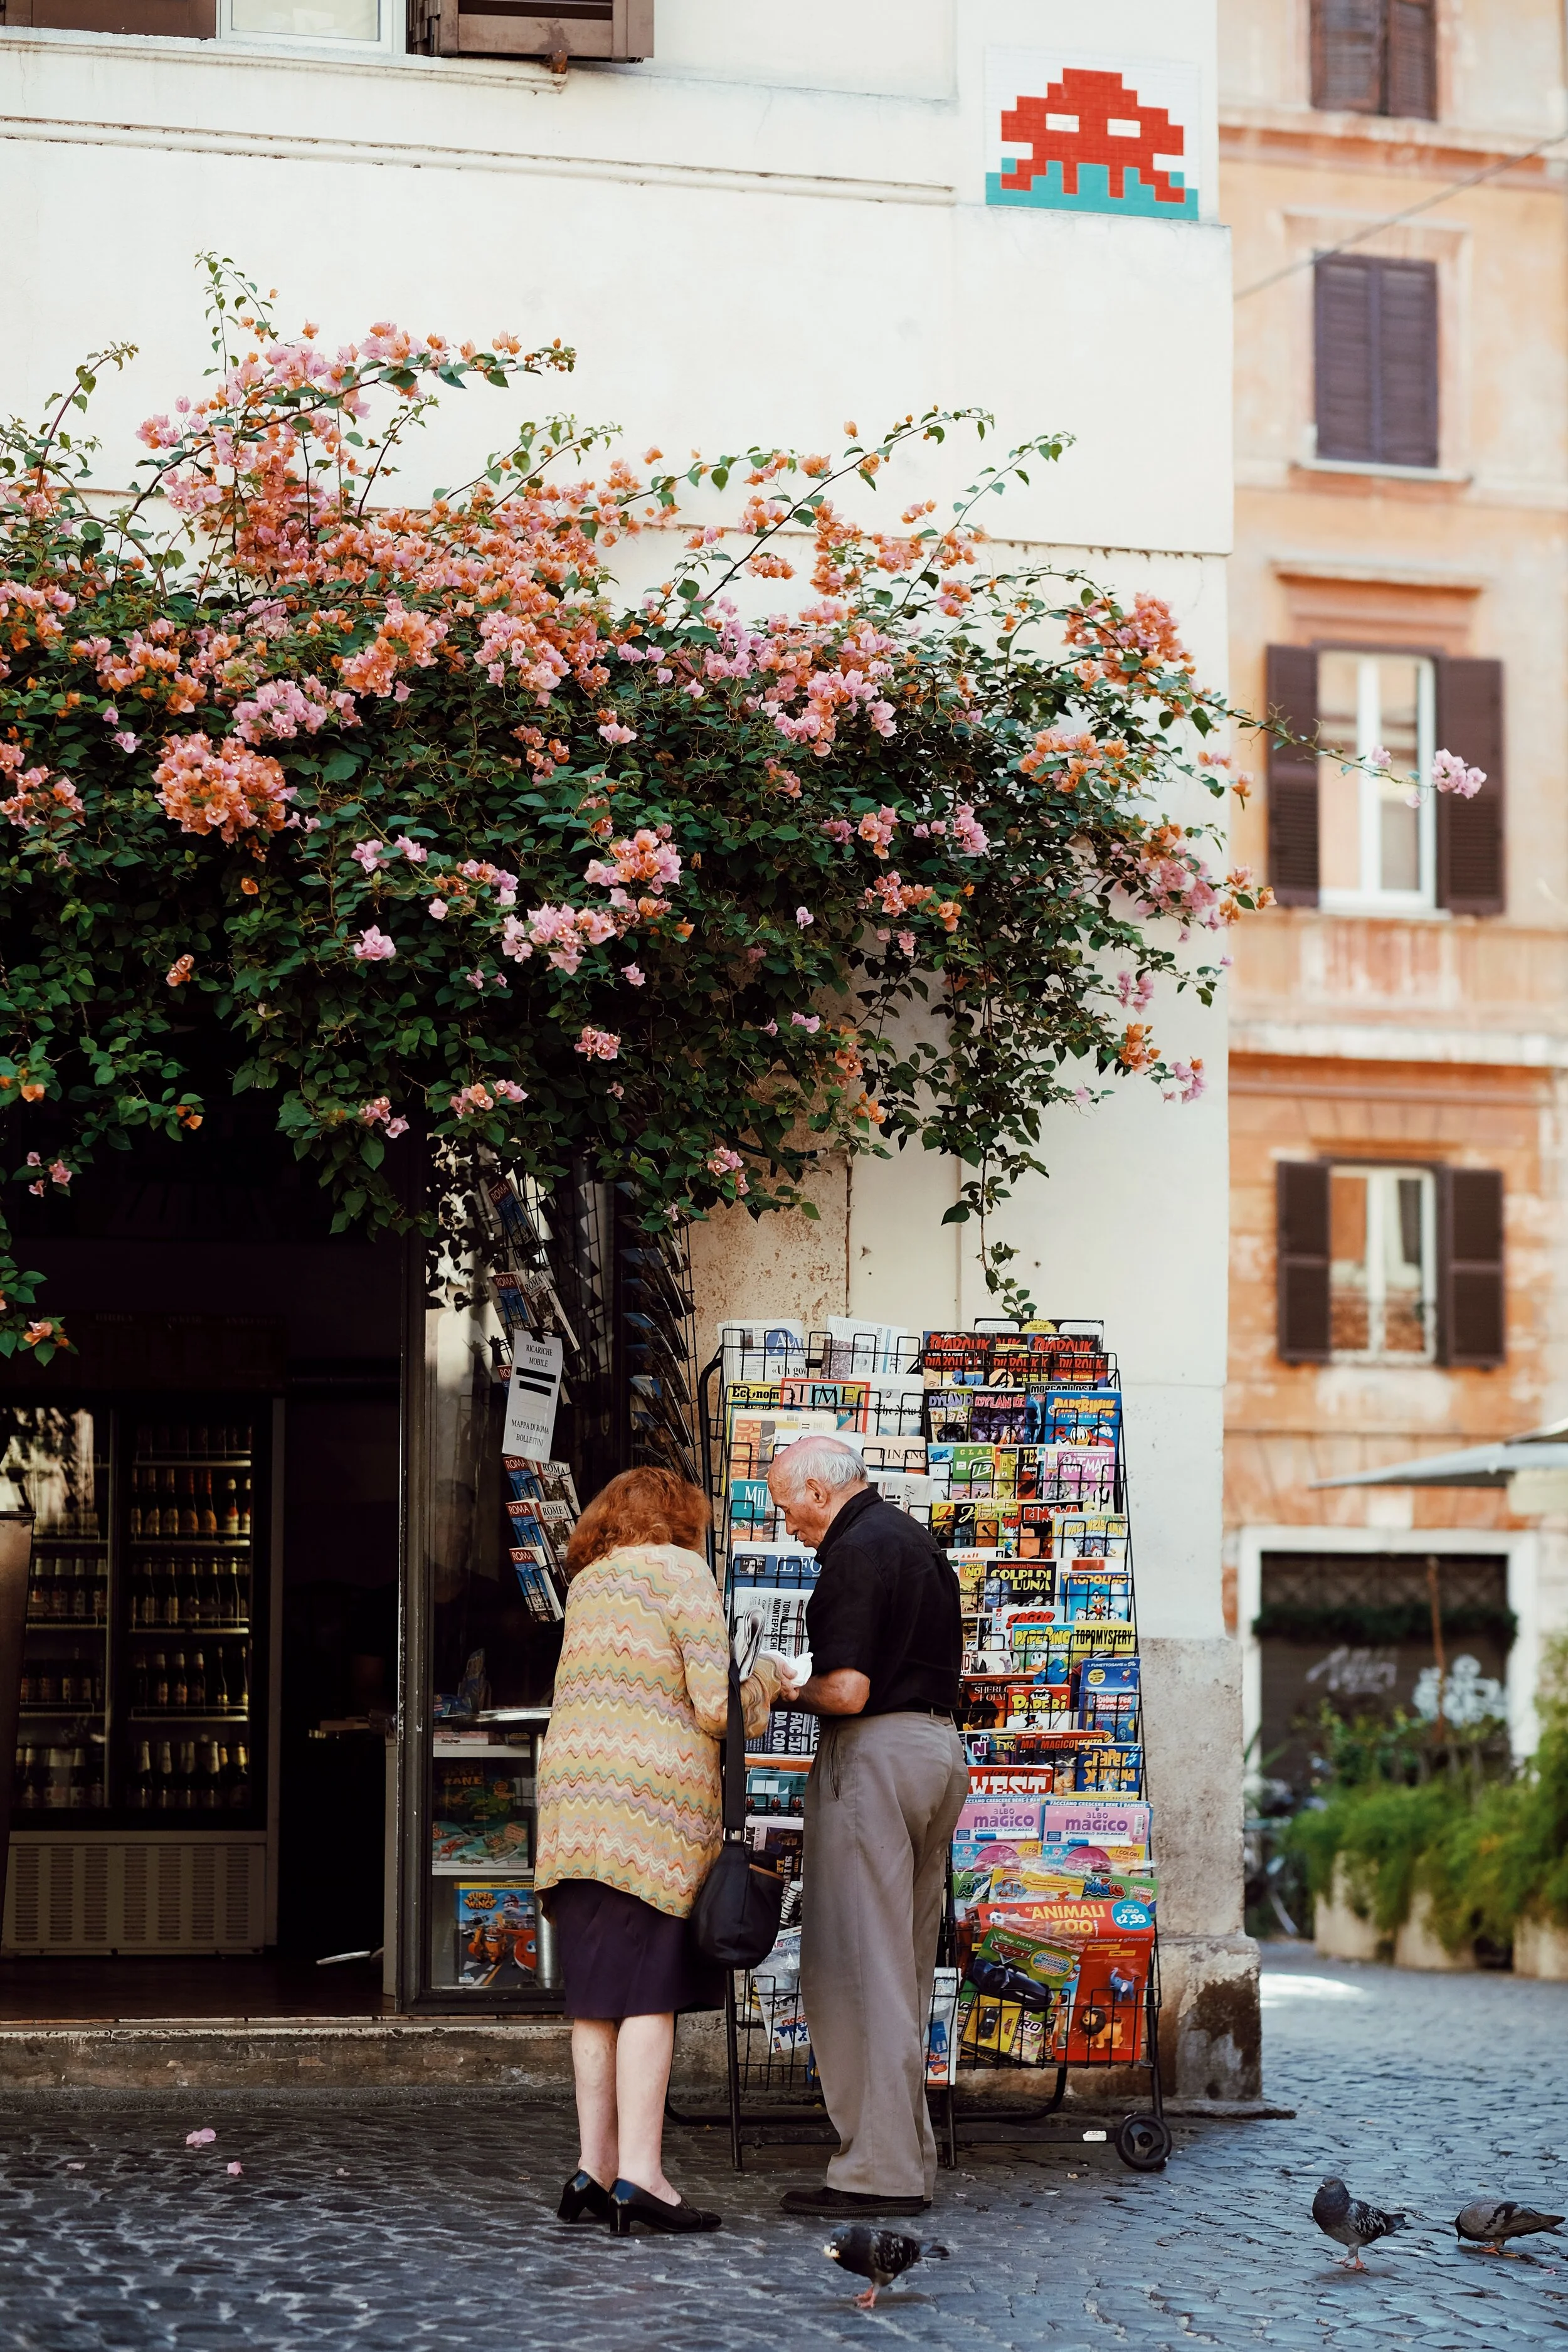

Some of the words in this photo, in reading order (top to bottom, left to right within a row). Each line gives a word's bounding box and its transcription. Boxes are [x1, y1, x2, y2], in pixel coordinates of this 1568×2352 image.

[490, 1183, 509, 1200] ROMA
[495, 1277, 515, 1286] ROMA
[525, 1275, 543, 1292] ROMA
[930, 1334, 990, 1350] DIABOLIK
[1033, 1335, 1093, 1352] DIABOLIK
[526, 1345, 553, 1356] RICARICHE
[529, 1357, 548, 1367] MOBILE
[732, 1387, 780, 1399] Econom
[795, 1383, 855, 1405] TIME
[1030, 1384, 1070, 1394] MORGAN
[928, 1395, 963, 1407] DYLAN
[974, 1396, 1012, 1409] DYLAN
[874, 1404, 892, 1417] The
[1052, 1397, 1116, 1419] PAPERINIK
[511, 1419, 529, 1430] MAPPA
[536, 1424, 549, 1434] ROMA
[751, 1420, 761, 1433] LA
[516, 1434, 543, 1446] BOLLETTINI
[930, 1449, 949, 1463] TEX
[506, 1459, 526, 1469] ROMA
[543, 1463, 565, 1475] ROMA
[1062, 1453, 1110, 1473] RAT-MAN
[508, 1504, 530, 1515] ROMA
[542, 1506, 564, 1516] ROME
[1024, 1505, 1079, 1521] KINOWA
[512, 1549, 533, 1560] ROMA
[774, 1555, 793, 1572] IL
[965, 1568, 982, 1577] NO
[990, 1569, 1031, 1581] COLPI
[1036, 1569, 1052, 1580] DI
[1071, 1572, 1128, 1585] TOPOLINO
[1012, 1579, 1051, 1591] LUNA
[781, 1601, 792, 1623] TORNA
[770, 1597, 781, 1650] MONTEPASCHI
[1005, 1611, 1055, 1629] ZAGOR
[1014, 1626, 1072, 1646] PAPERINO
[1076, 1629, 1133, 1645] TOPOMYSTERY
[1011, 1693, 1068, 1717] PAPERI
[774, 1712, 788, 1728] DA
[788, 1712, 803, 1752] FACCIA
[1041, 1739, 1074, 1749] MAGICO
[970, 1776, 1047, 1794] WEST
[1119, 1850, 1140, 1858] COLORI
[793, 1849, 802, 1873] Nyma
[994, 1881, 1028, 1897] PAW
[1084, 1882, 1125, 1896] MASKS
[468, 1891, 494, 1901] SUPER
[466, 1899, 495, 1909] WINGS
[1032, 1904, 1106, 1920] ANIMALI
[1116, 1914, 1147, 1926] €2,99
[1051, 1918, 1094, 1936] ZOO
[998, 1932, 1015, 1944] Disney
